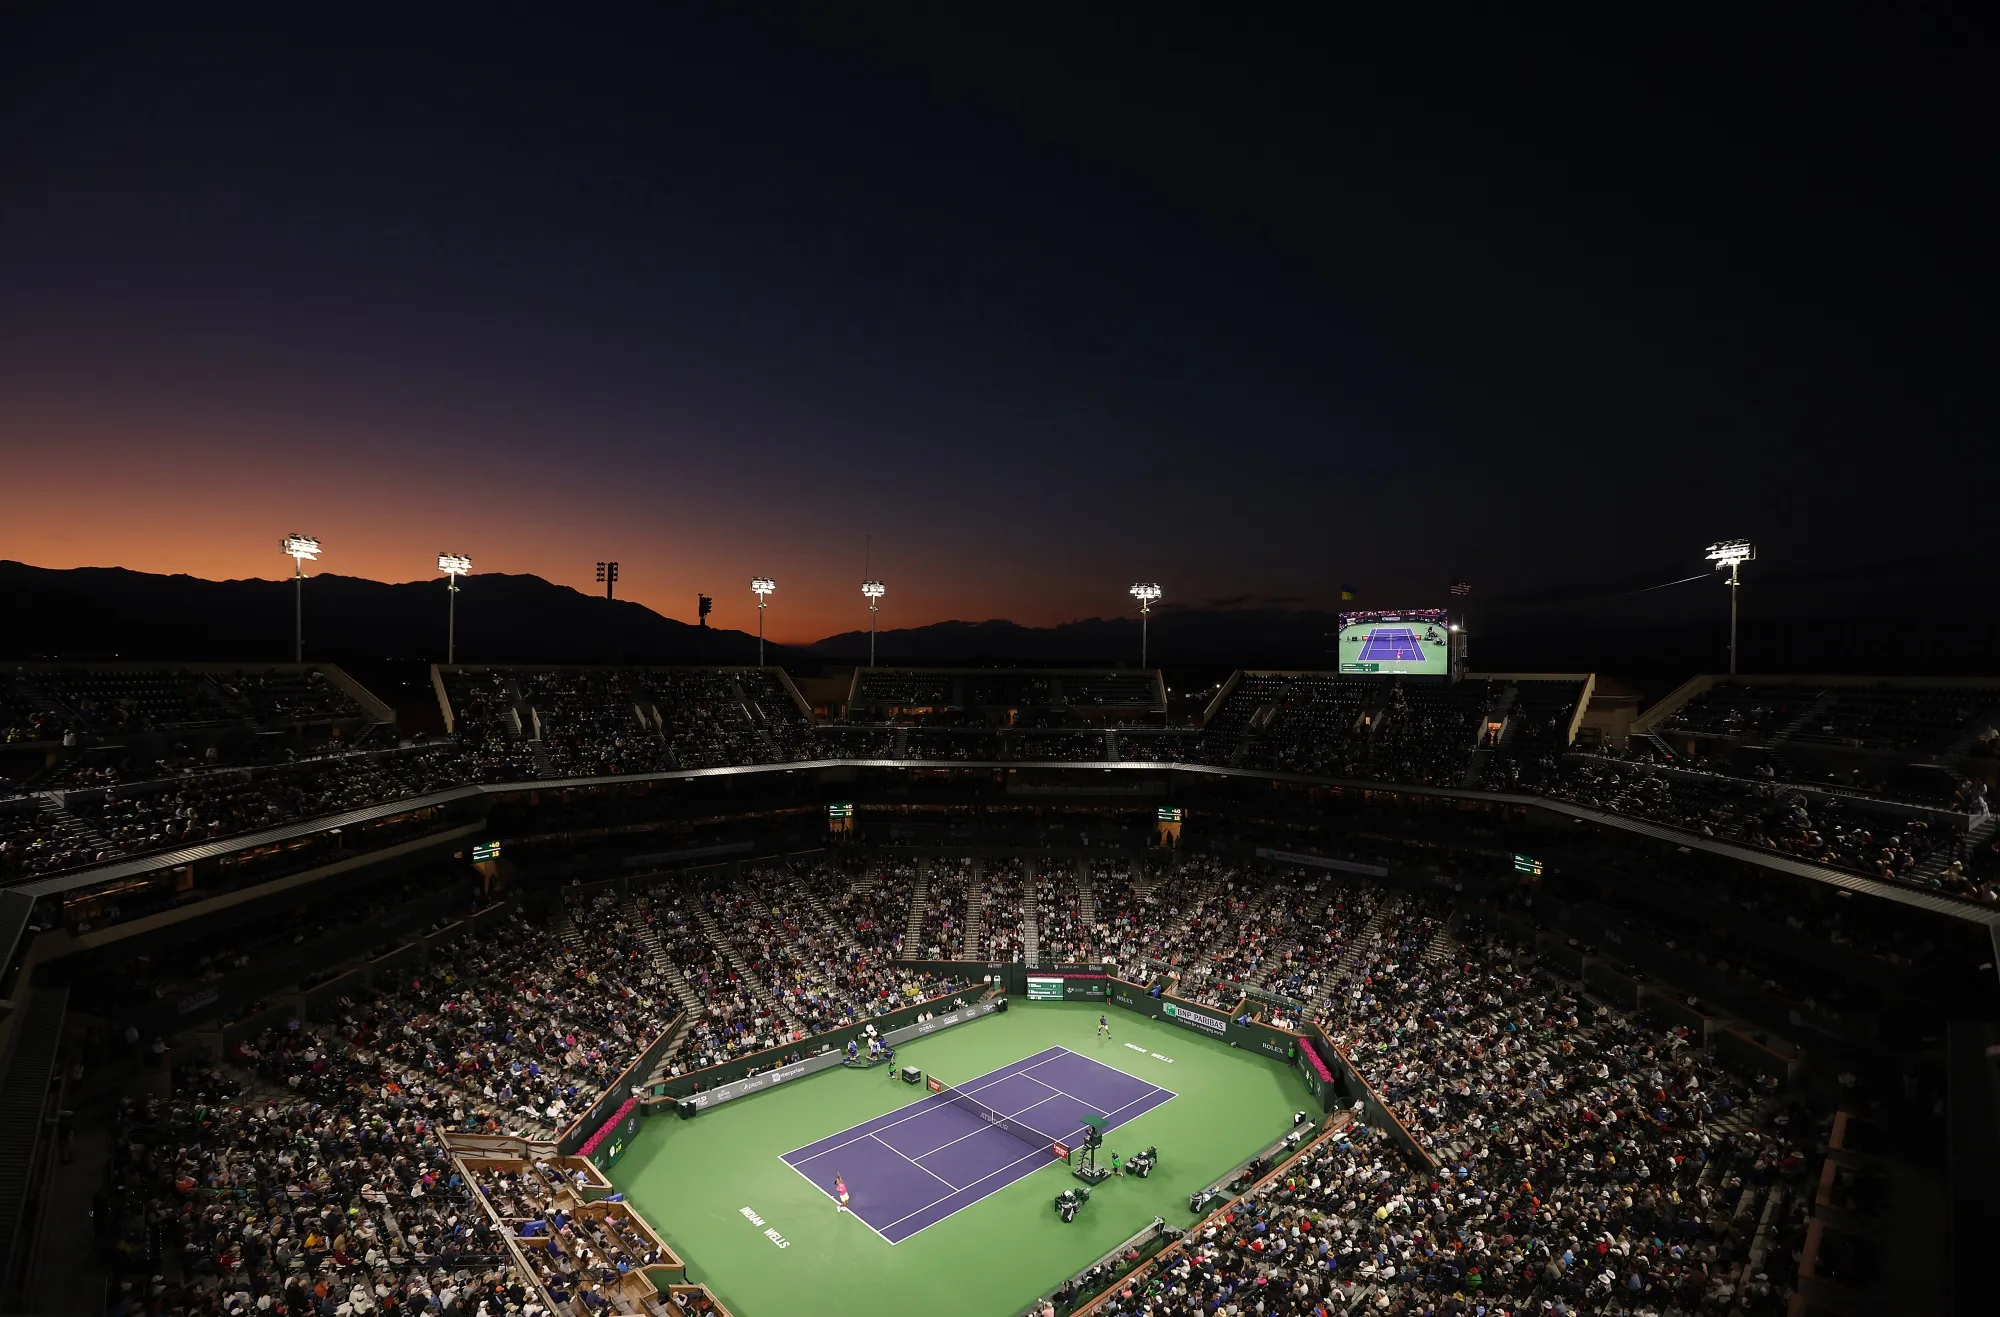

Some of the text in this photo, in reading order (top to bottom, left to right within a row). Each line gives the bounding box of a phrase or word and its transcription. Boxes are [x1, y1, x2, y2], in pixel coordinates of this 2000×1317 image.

[1177, 1008, 1224, 1030] BNP PARIBAS
[918, 1023, 936, 1033] DOBEL
[1124, 1042, 1174, 1064] INDIAN WELLS
[1262, 1042, 1284, 1054] ROLEX
[748, 1079, 763, 1090] pepsi
[980, 1112, 993, 1123] ATP
[739, 1206, 791, 1249] INDIAN WELLS
